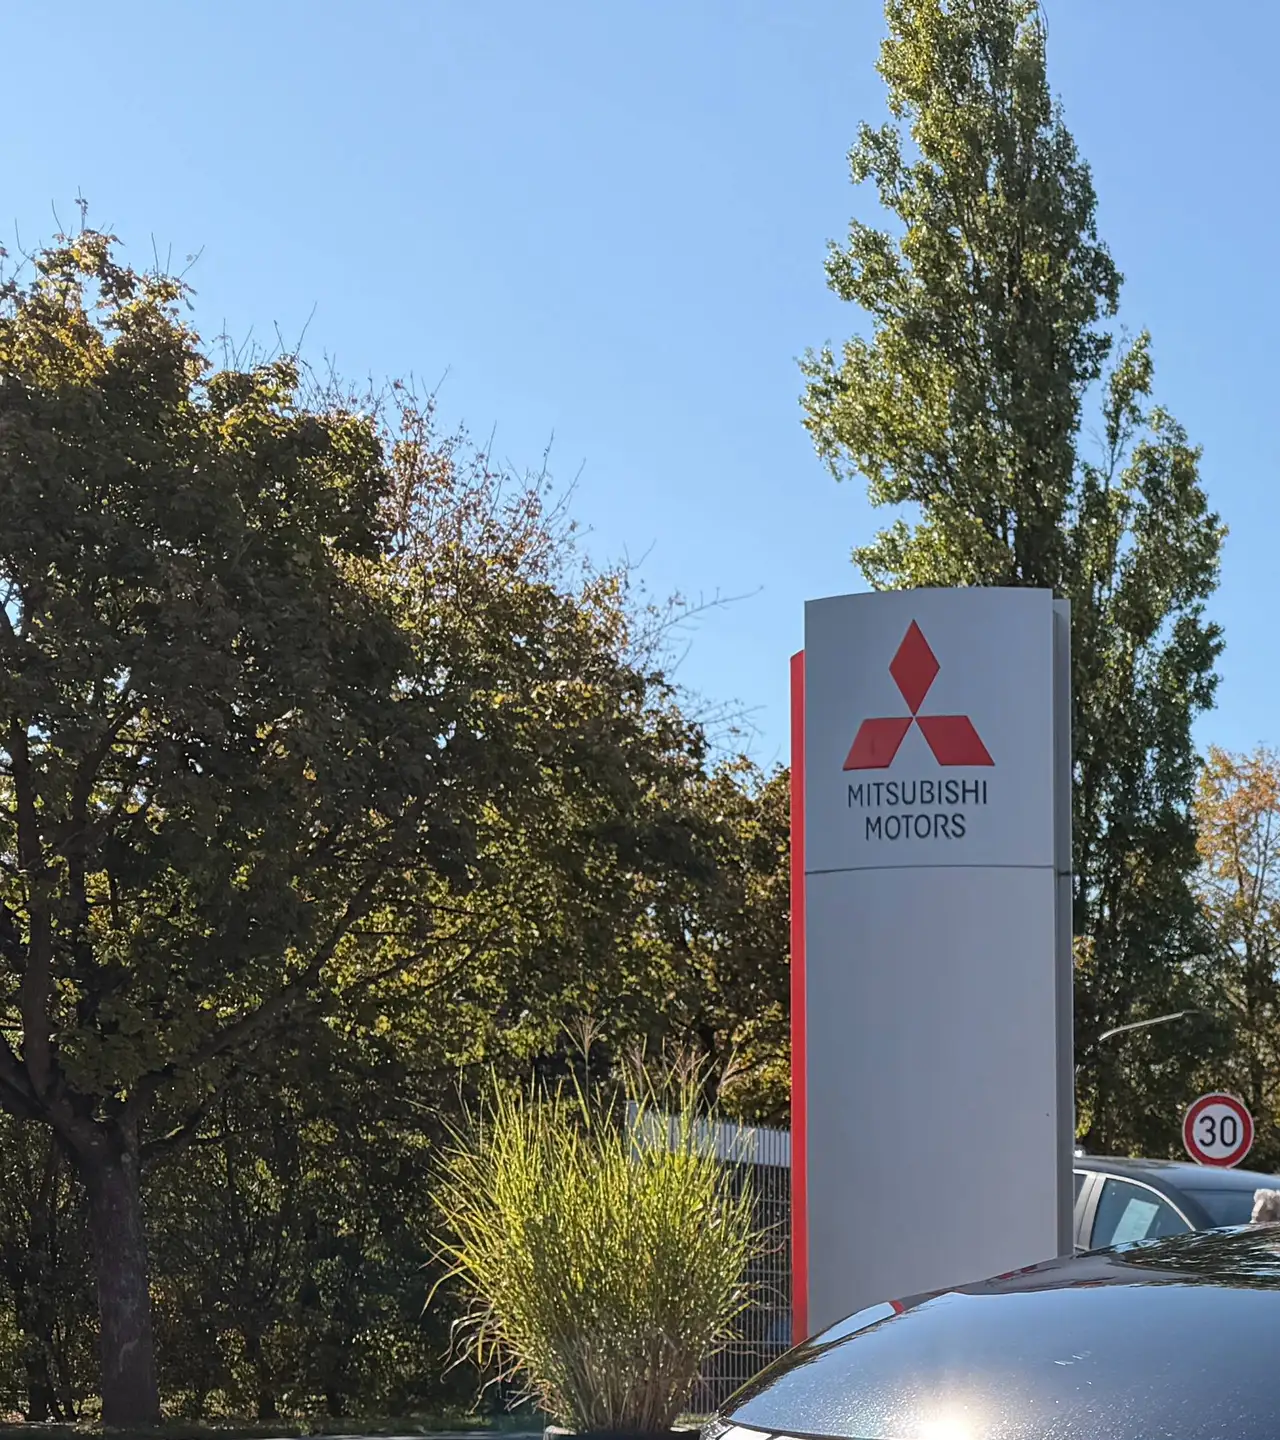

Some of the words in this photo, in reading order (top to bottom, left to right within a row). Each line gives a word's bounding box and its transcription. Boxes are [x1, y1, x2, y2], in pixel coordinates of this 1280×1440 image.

[848, 780, 988, 808] MITSUBISHI
[865, 813, 967, 841] MOTORS
[1199, 1115, 1237, 1147] 30
